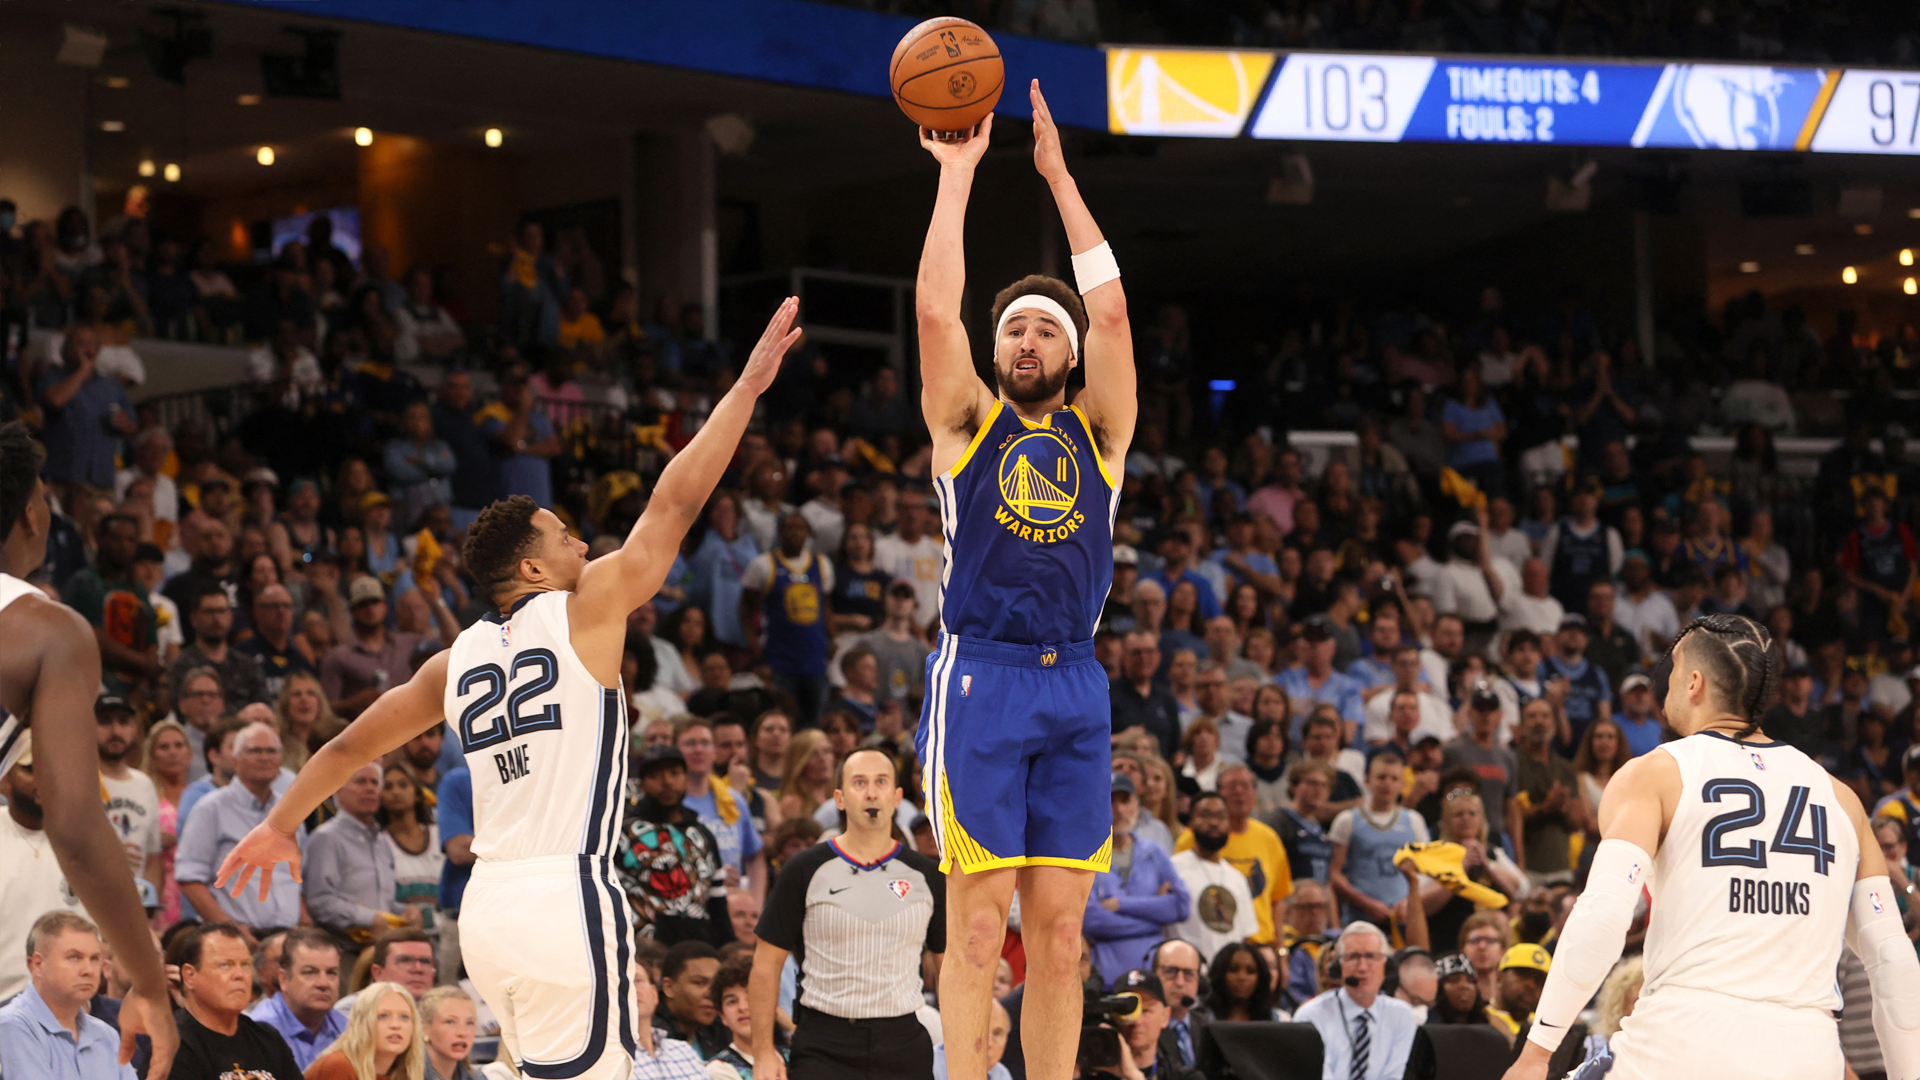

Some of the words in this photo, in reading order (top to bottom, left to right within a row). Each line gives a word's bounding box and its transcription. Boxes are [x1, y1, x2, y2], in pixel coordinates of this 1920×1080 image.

[1304, 63, 1388, 132] 103
[1446, 66, 1579, 105] TIMEOUTS:
[1581, 69, 1600, 105] 4
[1446, 104, 1534, 142] FOULS:
[1535, 105, 1555, 142] 2
[1869, 79, 1920, 147] 97
[1056, 456, 1068, 482] 11
[994, 504, 1086, 544] WARRIORS
[457, 647, 563, 755] 22
[493, 743, 530, 785] BANE
[1701, 777, 1836, 877] 24
[1728, 877, 1811, 916] BROOKS
